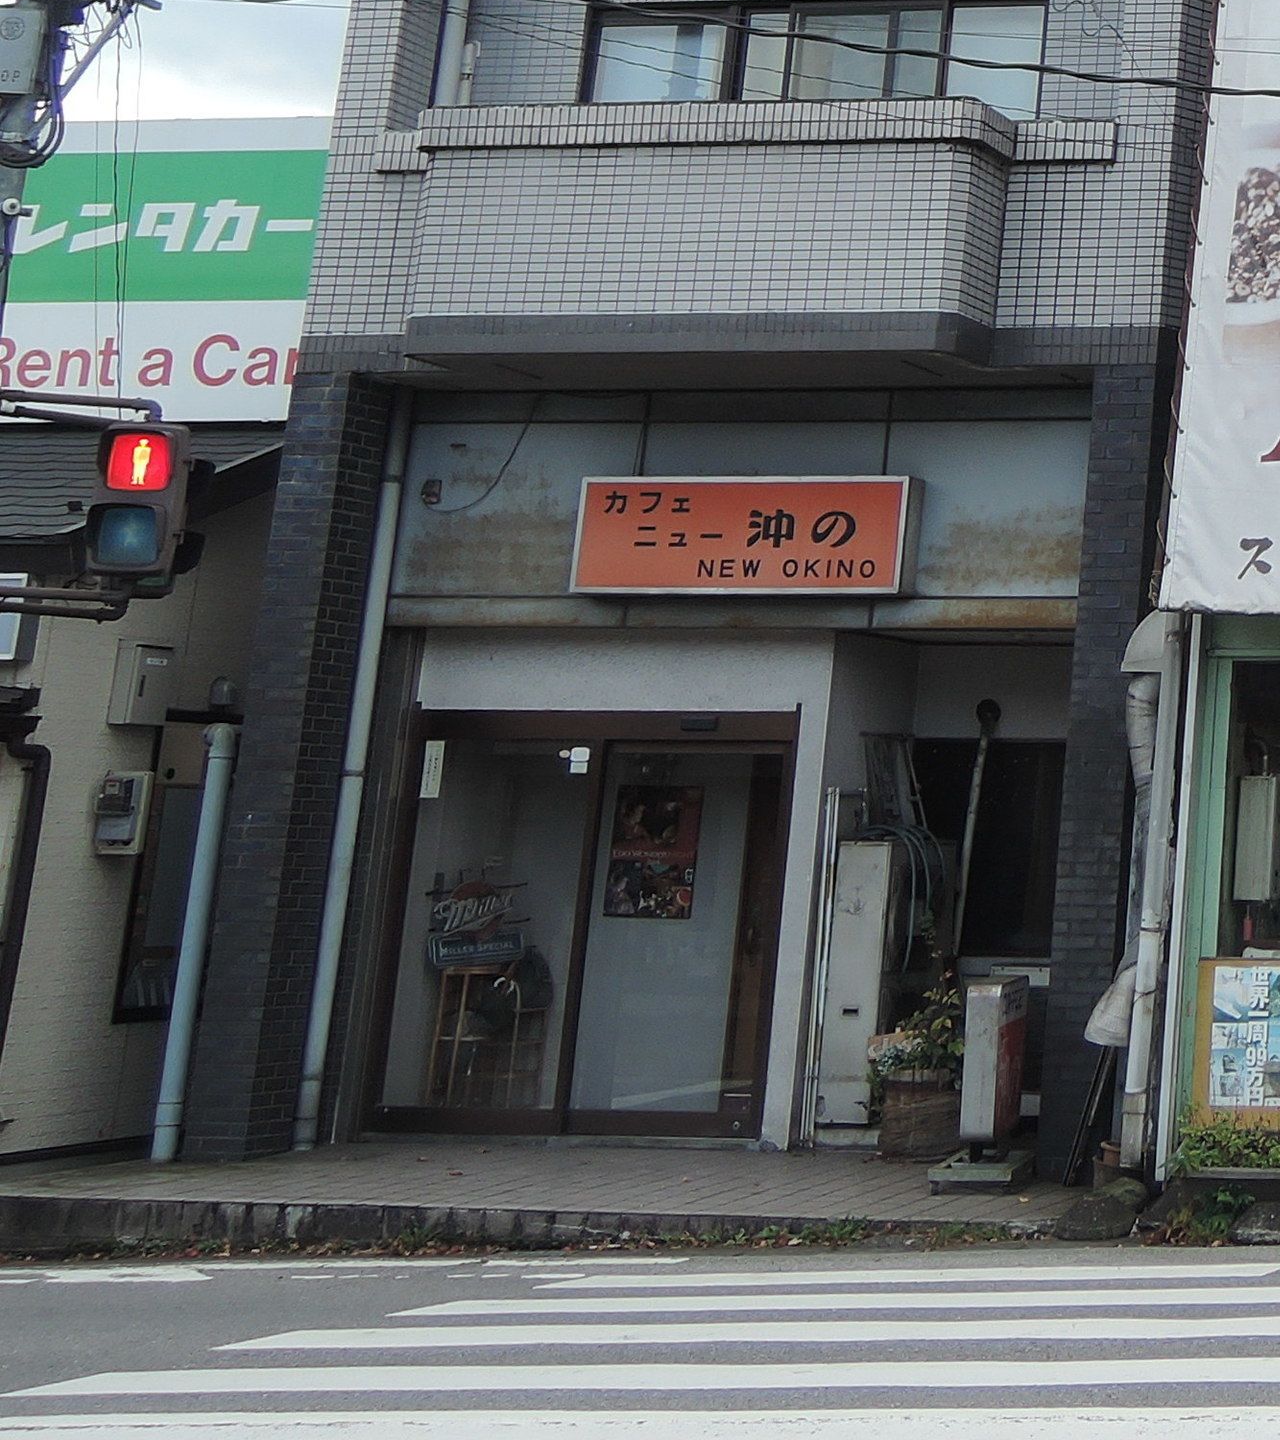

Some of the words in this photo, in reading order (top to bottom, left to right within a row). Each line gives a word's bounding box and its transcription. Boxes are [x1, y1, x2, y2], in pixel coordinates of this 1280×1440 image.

[13, 199, 314, 254] レンタカー
[138, 348, 174, 387] a
[604, 491, 691, 514] カフェ
[634, 526, 723, 547] ニュー
[747, 509, 857, 548] 沖の
[697, 559, 761, 578] NEW
[782, 559, 877, 579] OKINO
